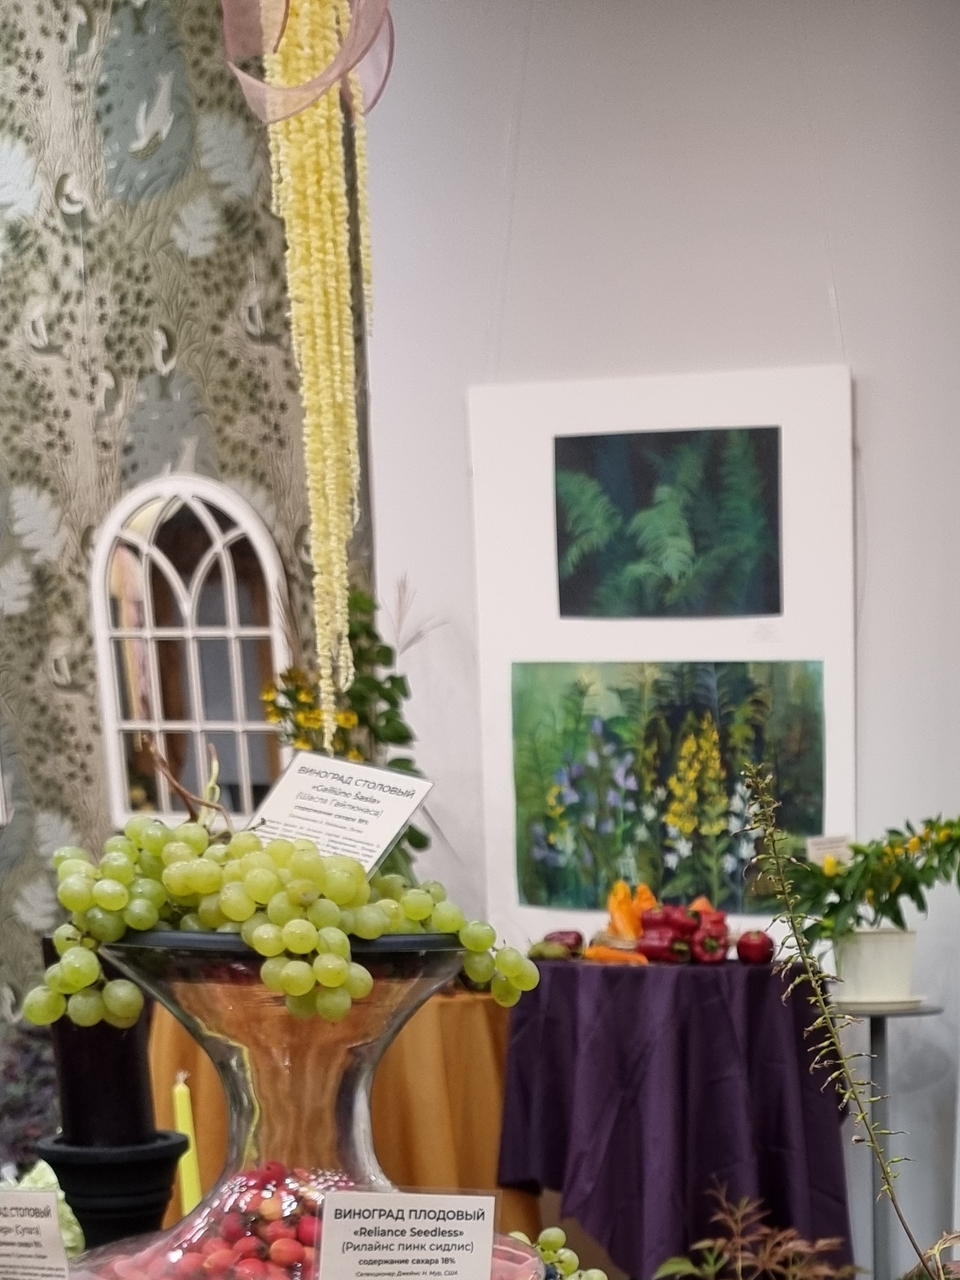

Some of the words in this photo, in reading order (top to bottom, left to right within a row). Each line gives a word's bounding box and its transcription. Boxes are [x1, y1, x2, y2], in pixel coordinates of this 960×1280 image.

[297, 766, 354, 786] ВИНОГРАД
[354, 778, 416, 799] СТОЛОВЫЙ
[9, 1204, 52, 1219] СТОЛОВЫЙ
[334, 1208, 405, 1222] ВИНОГРАД
[408, 1206, 486, 1222] ПЛОДОВЫЙ
[353, 1226, 407, 1238] «Reliance
[409, 1227, 464, 1238] Seedless»
[341, 1241, 395, 1254] (Рилайнс
[397, 1243, 426, 1252] пинк
[429, 1241, 475, 1254] сидлис)
[358, 1257, 409, 1266] содержание
[411, 1257, 440, 1266] сахара
[441, 1257, 456, 1265] 18%
